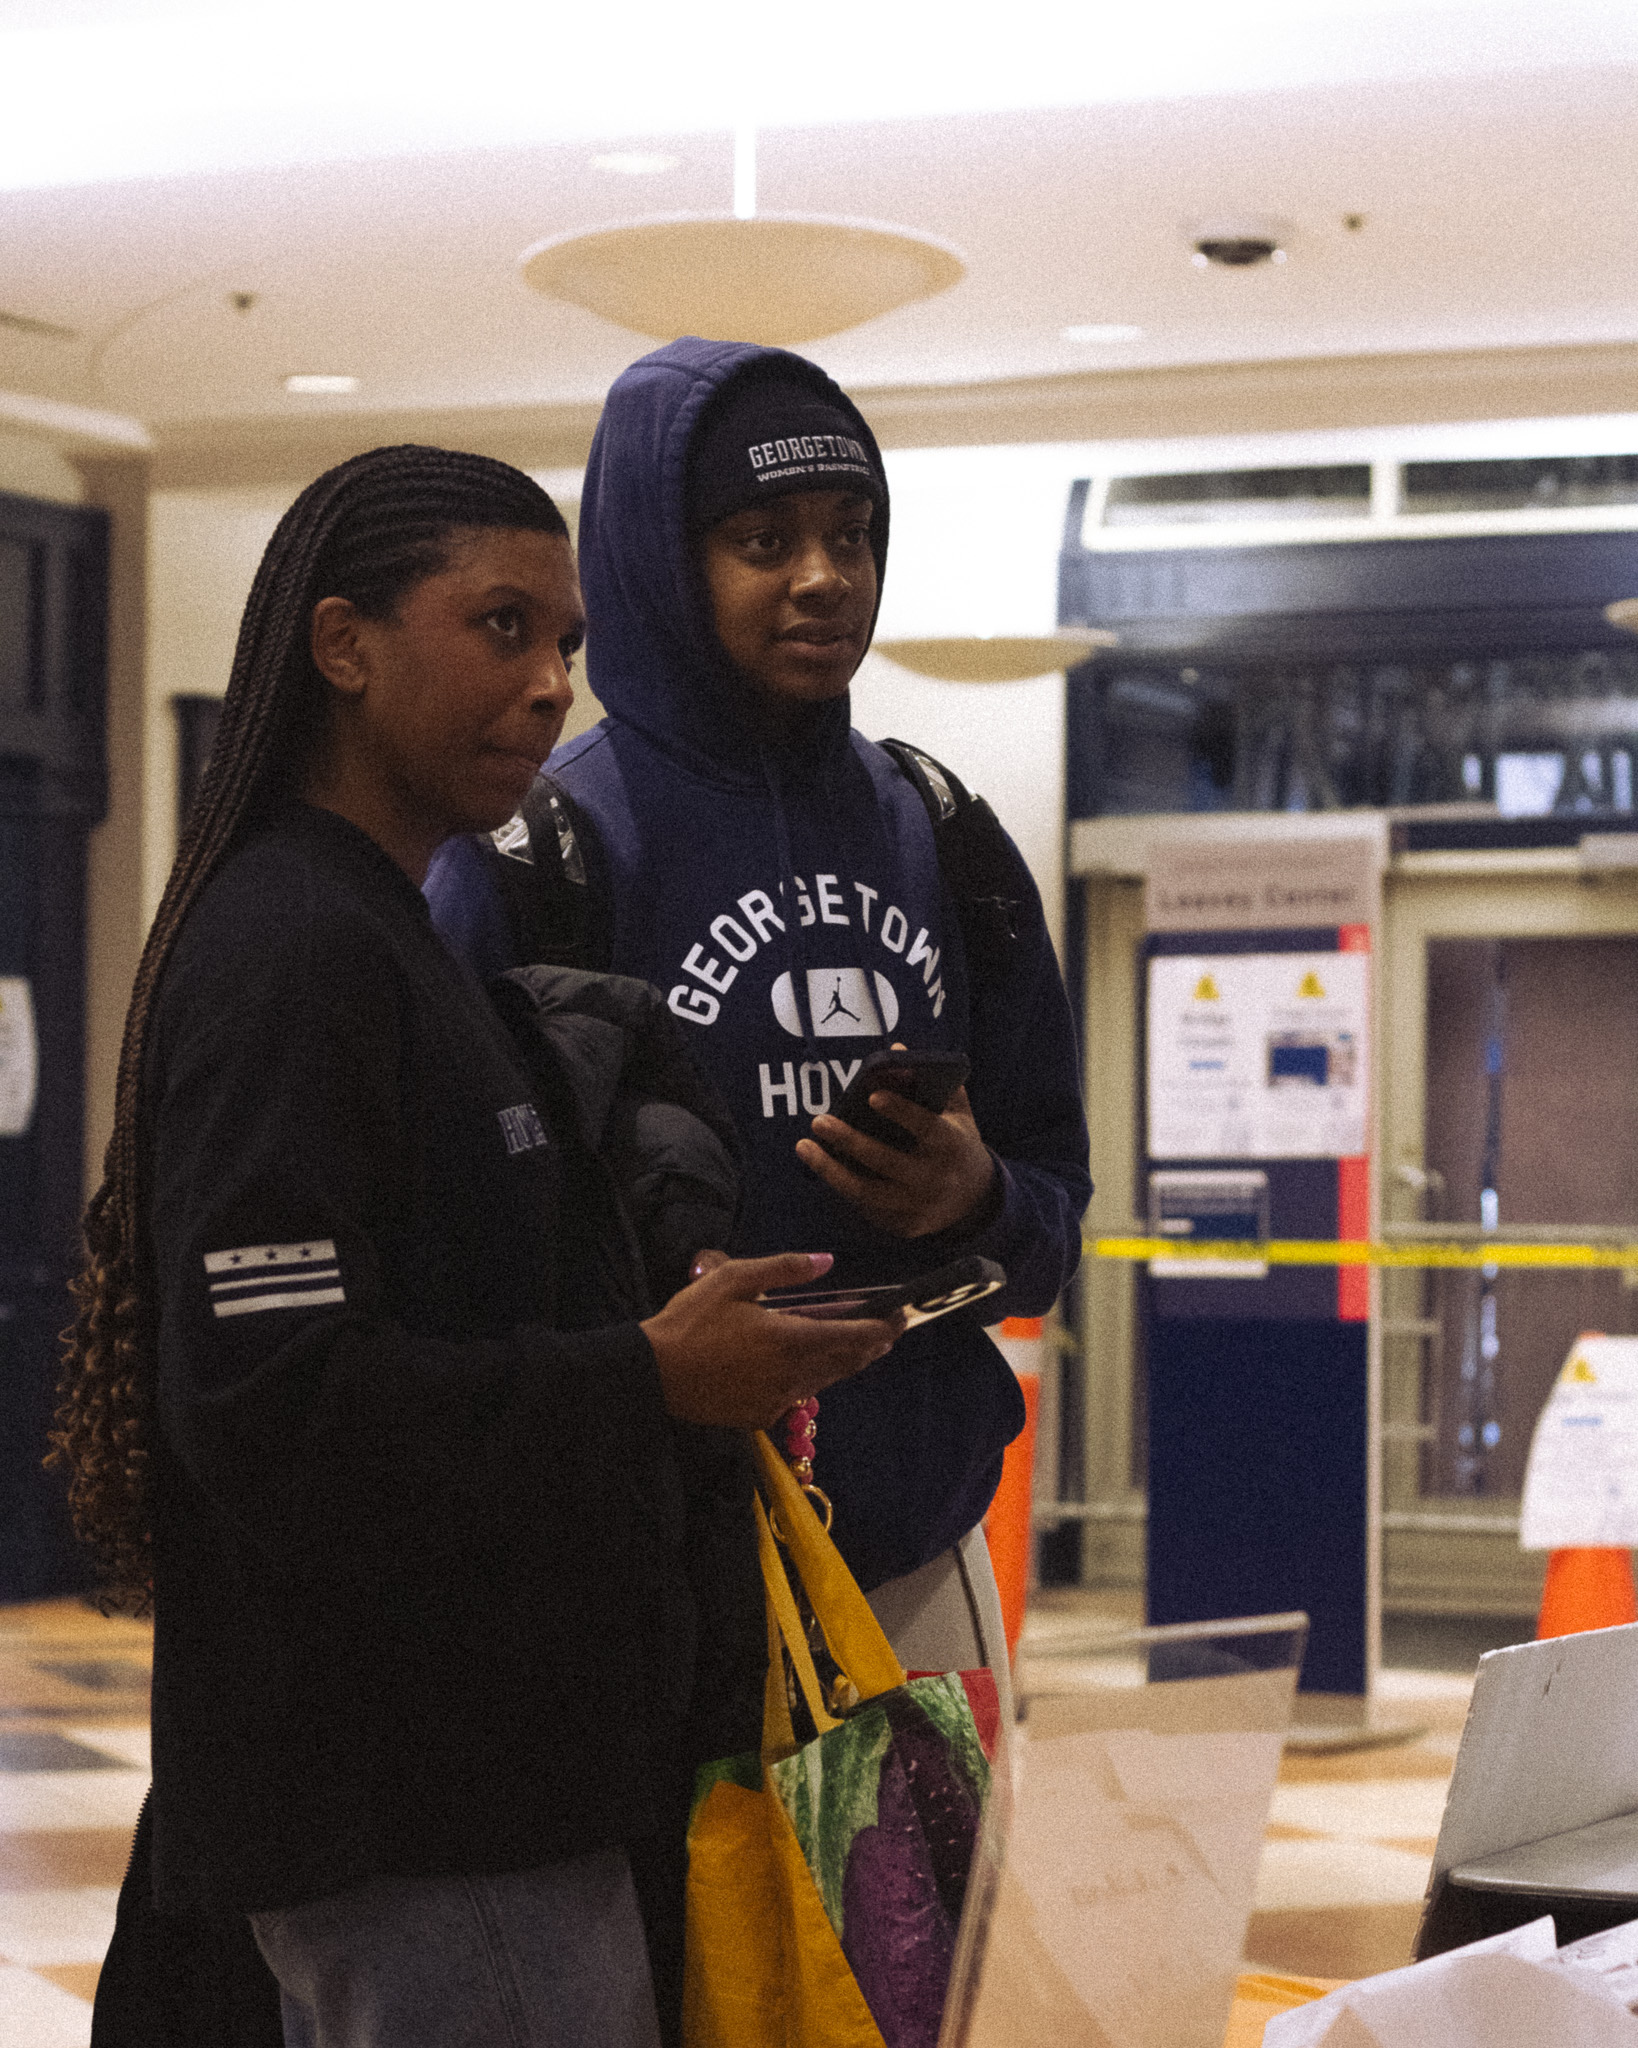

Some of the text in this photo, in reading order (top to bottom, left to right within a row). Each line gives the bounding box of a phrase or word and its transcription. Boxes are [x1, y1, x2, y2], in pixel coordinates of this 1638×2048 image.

[748, 435, 868, 469] GEORGETOWN
[756, 464, 814, 482] WOMEN'S
[667, 874, 946, 1026] GEORGETOWN
[758, 1059, 863, 1118] HOY
